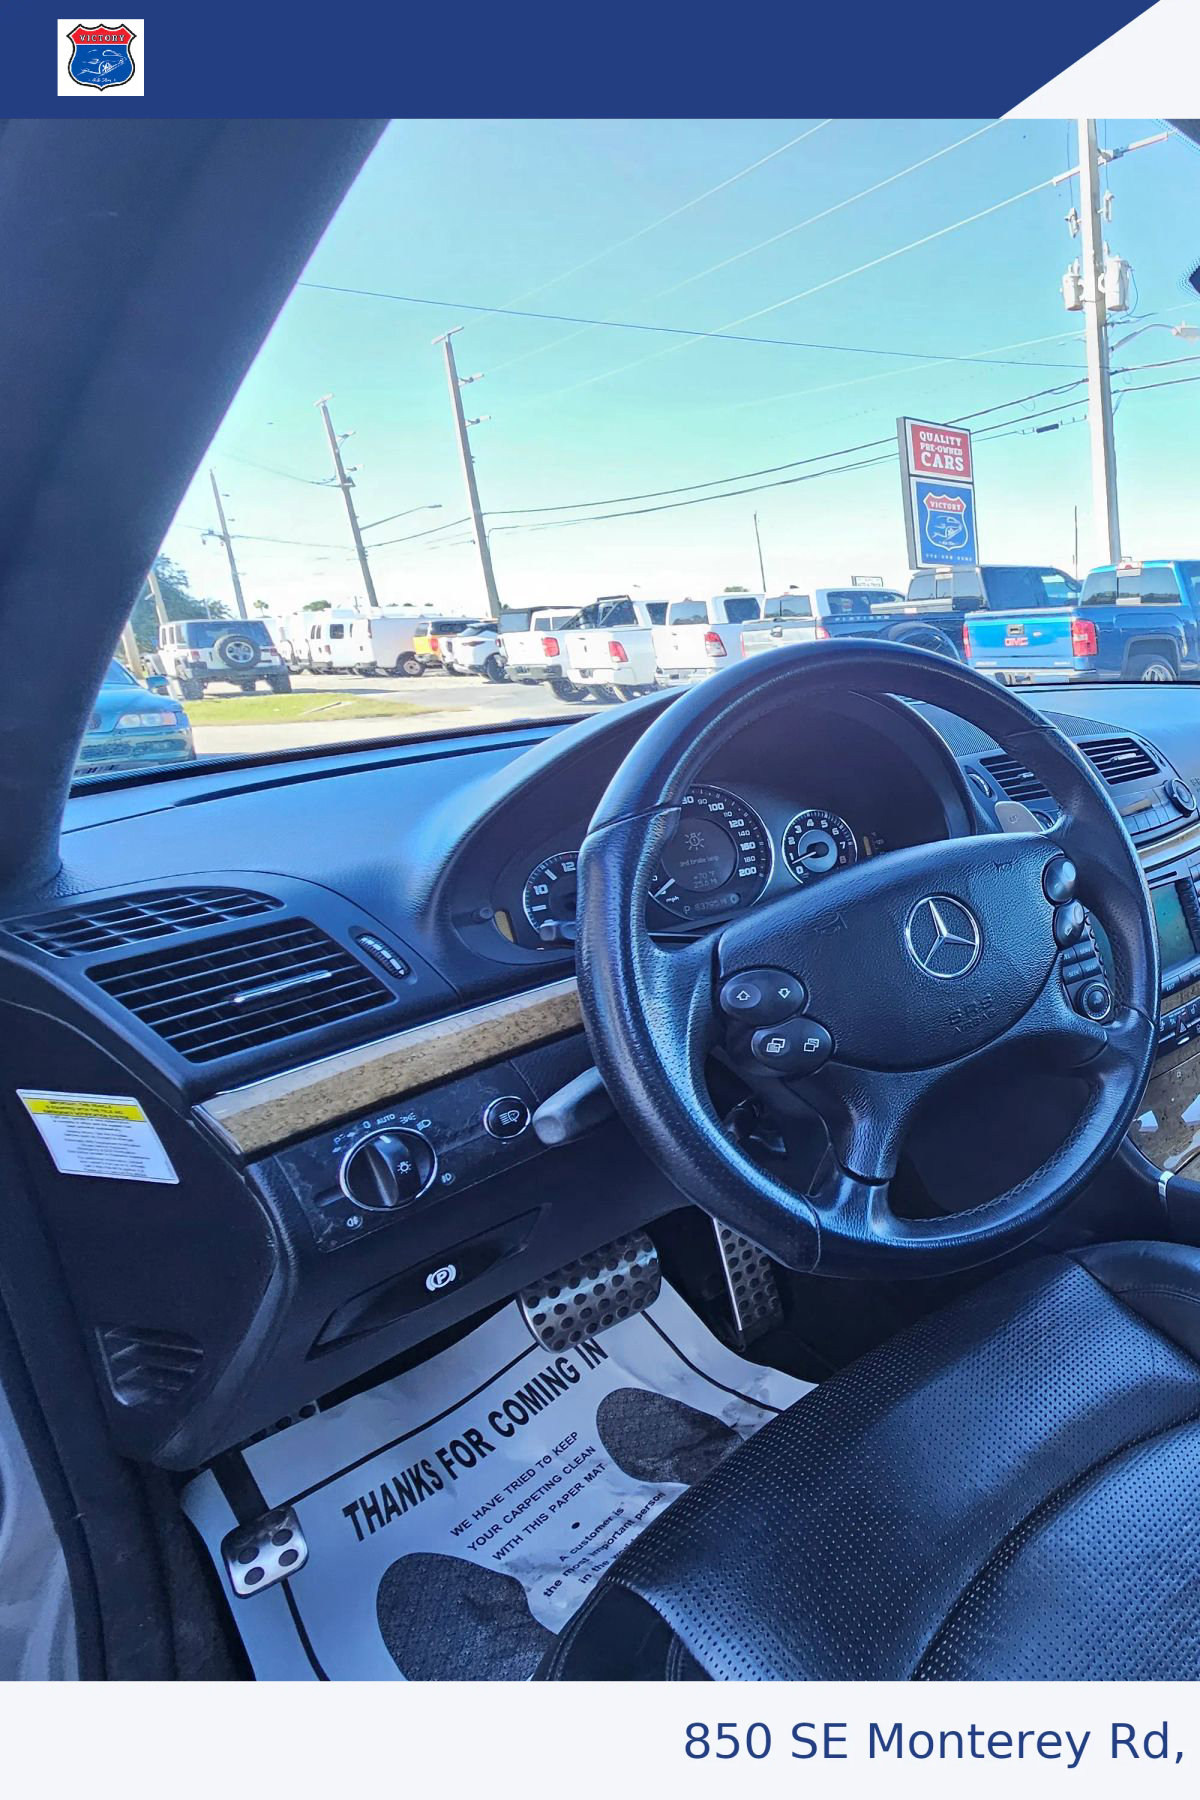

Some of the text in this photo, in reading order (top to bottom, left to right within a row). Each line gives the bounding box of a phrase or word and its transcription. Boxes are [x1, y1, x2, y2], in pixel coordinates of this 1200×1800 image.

[919, 430, 962, 447] QUALITY
[919, 442, 963, 456] PRE-OWNED
[921, 451, 964, 472] CARS
[930, 500, 962, 511] VICTORY
[1004, 637, 1029, 647] GMC
[708, 802, 725, 812] 100
[728, 818, 745, 829] 120
[794, 824, 803, 834] 3
[820, 819, 829, 828] 5
[839, 841, 847, 850] 7
[561, 861, 576, 872] 12
[738, 866, 757, 877] 200
[533, 883, 549, 895] 10
[376, 1113, 396, 1125] AUTO
[341, 1337, 609, 1542] THANKS FOR COMING IN
[450, 1431, 579, 1537] WE HAVE TRIED TO KEEP
[467, 1445, 597, 1552] YOUR CARPETING CLEAN
[491, 1462, 608, 1561] WITH THIS PAPER MAT
[543, 1579, 563, 1598] the
[562, 1556, 591, 1577] most
[588, 1518, 636, 1557] important
[634, 1491, 667, 1520] person
[559, 1555, 570, 1563] A
[568, 1515, 615, 1555] customer
[578, 1559, 610, 1585] in the
